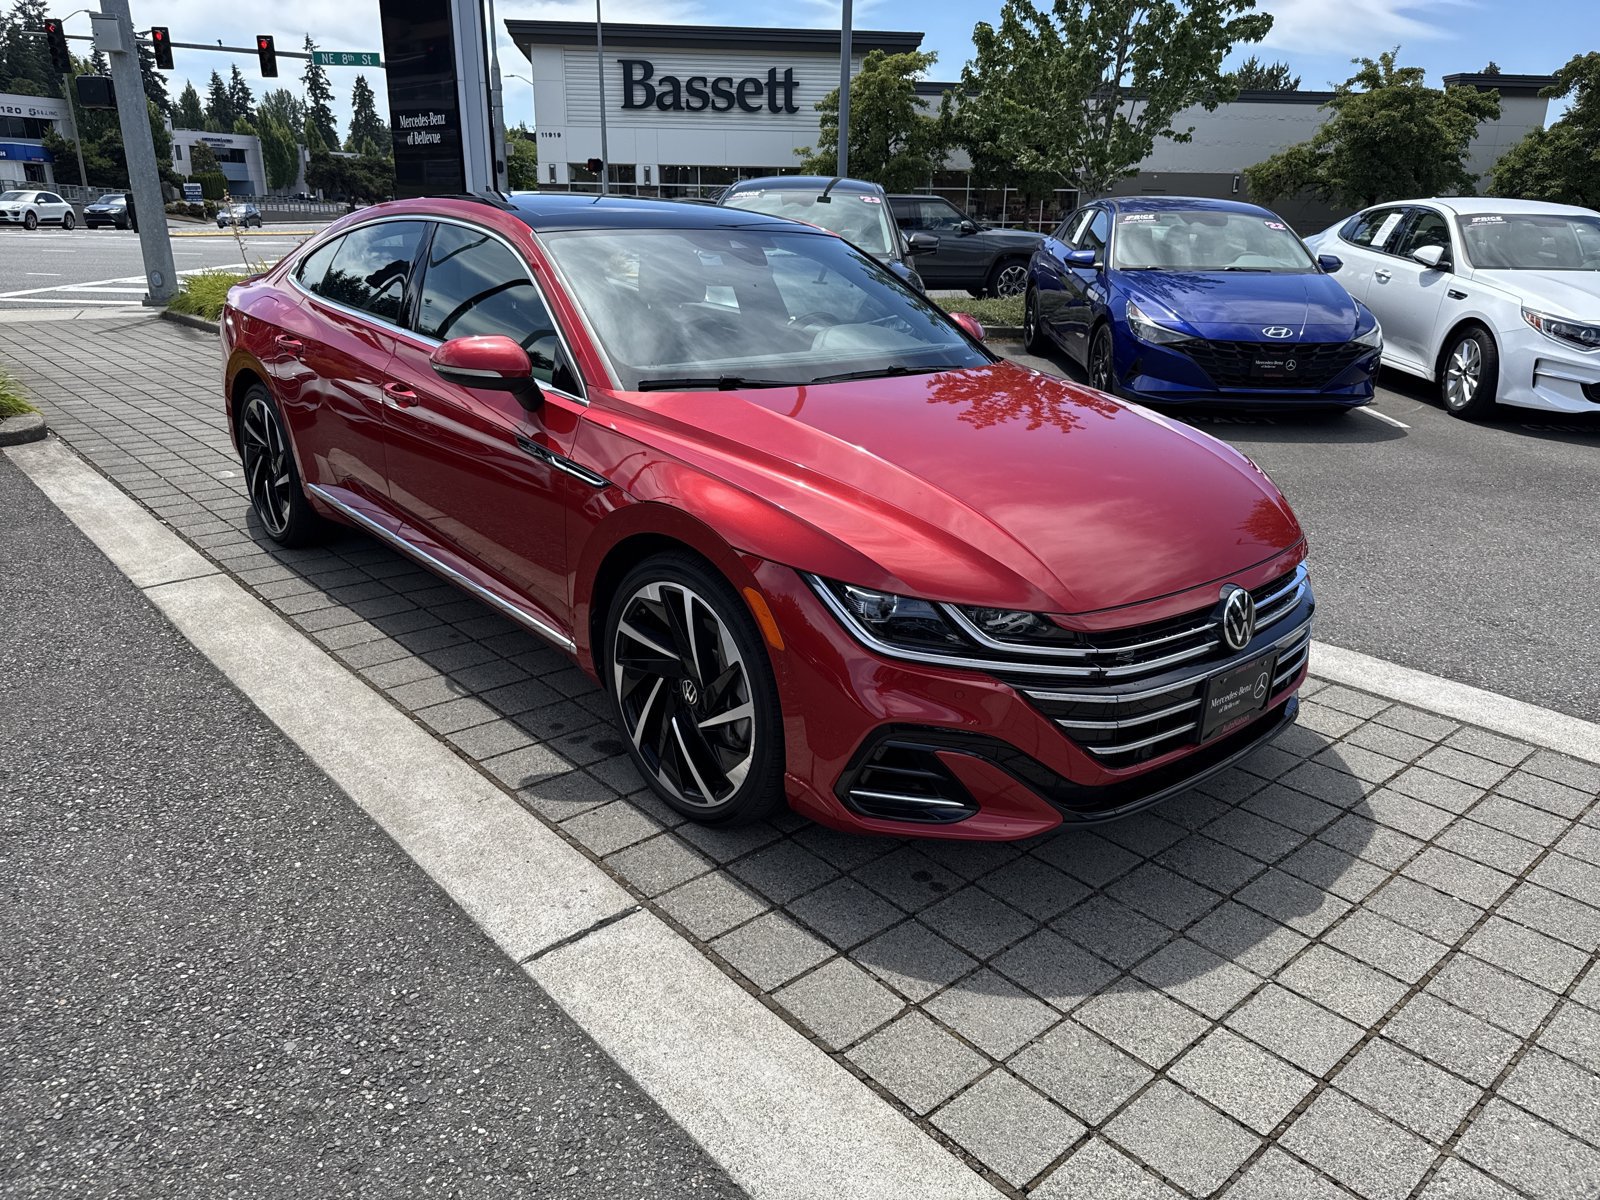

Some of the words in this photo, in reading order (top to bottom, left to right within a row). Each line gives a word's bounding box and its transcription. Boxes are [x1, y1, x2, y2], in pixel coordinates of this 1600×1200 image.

[321, 53, 335, 64] NE
[342, 53, 354, 65] 8th
[361, 54, 372, 65] St
[617, 59, 799, 114] Bassett
[399, 111, 446, 129] Mercedes-Benz
[407, 131, 414, 145] of
[414, 130, 441, 145] Bellevue
[1211, 683, 1253, 709] Mercedes-Benz
